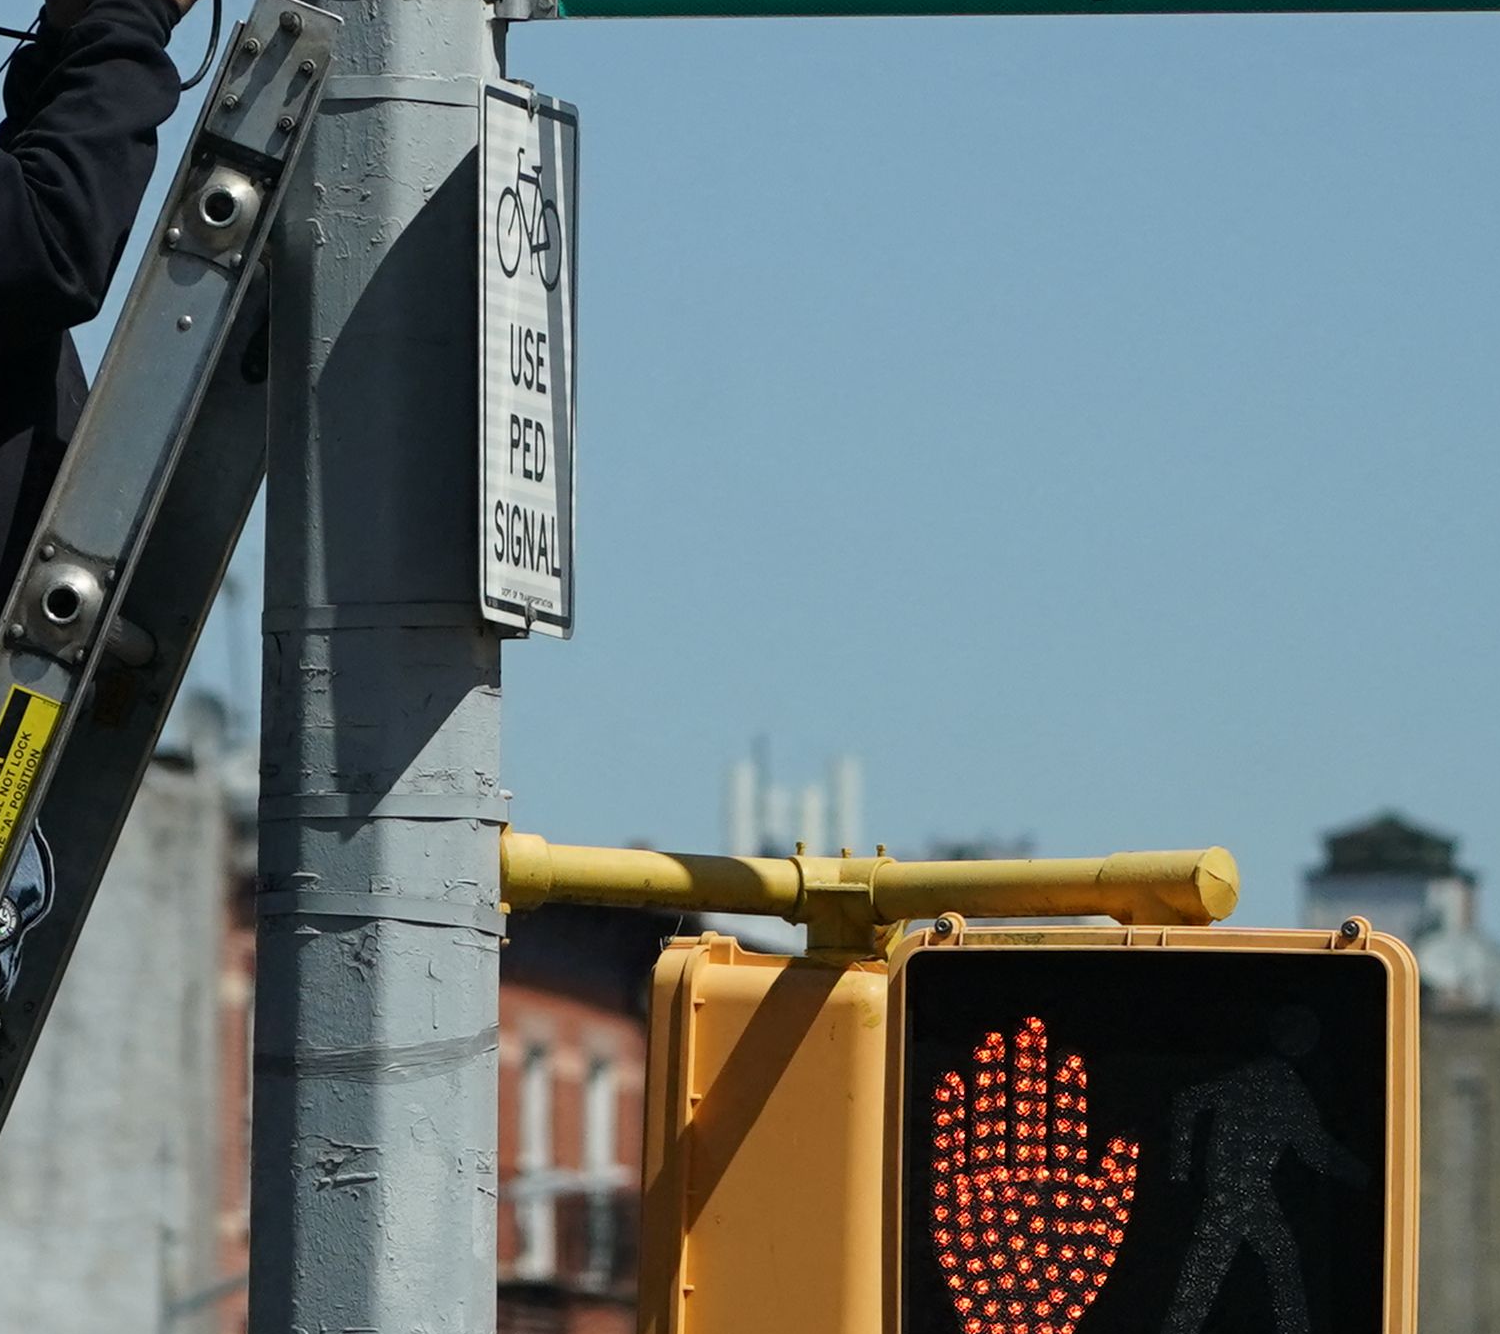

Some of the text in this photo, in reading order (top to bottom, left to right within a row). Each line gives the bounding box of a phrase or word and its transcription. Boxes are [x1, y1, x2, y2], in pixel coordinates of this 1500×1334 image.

[509, 323, 548, 394] USE
[509, 417, 546, 483] PED
[493, 499, 562, 578] SIGNAL
[10, 749, 41, 810] POSITION
[11, 731, 32, 768] LOCK
